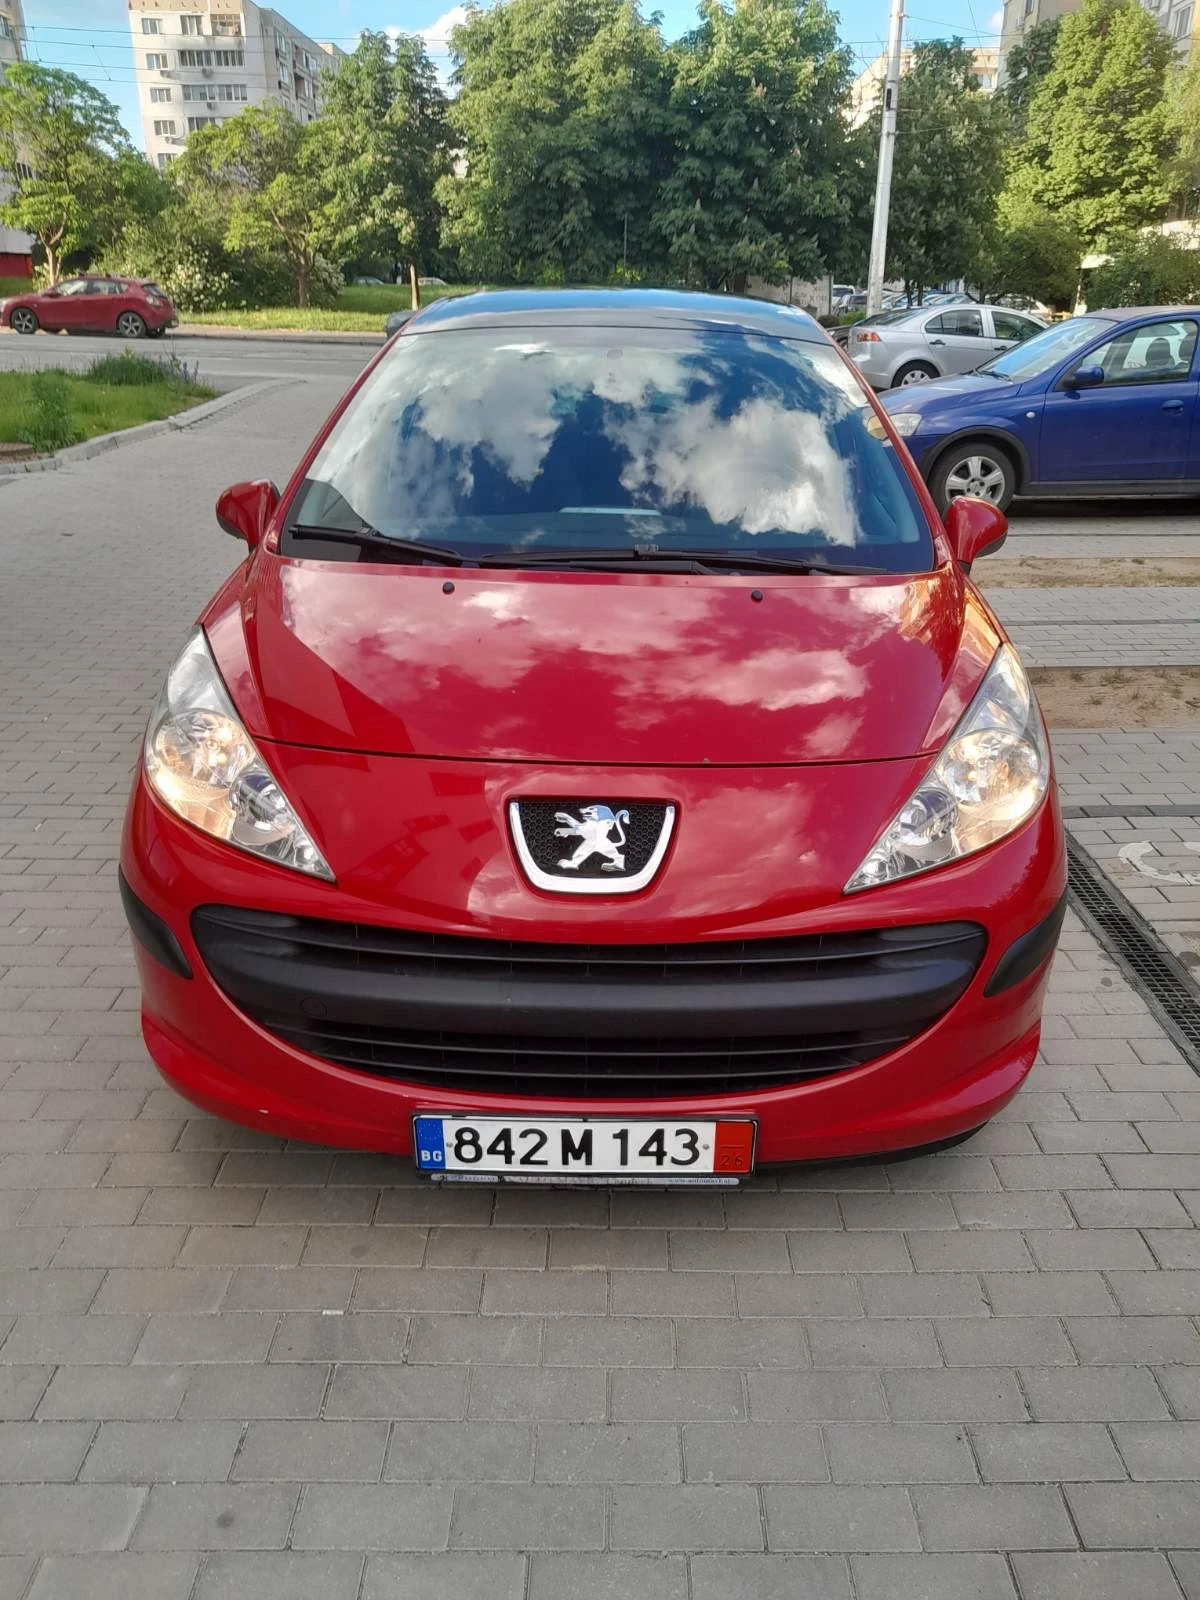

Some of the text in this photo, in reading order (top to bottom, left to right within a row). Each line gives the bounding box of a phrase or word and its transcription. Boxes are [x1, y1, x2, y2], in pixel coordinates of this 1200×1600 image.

[454, 1127, 700, 1166] 842 M 143
[421, 1150, 443, 1162] BG
[720, 1154, 744, 1168] 26
